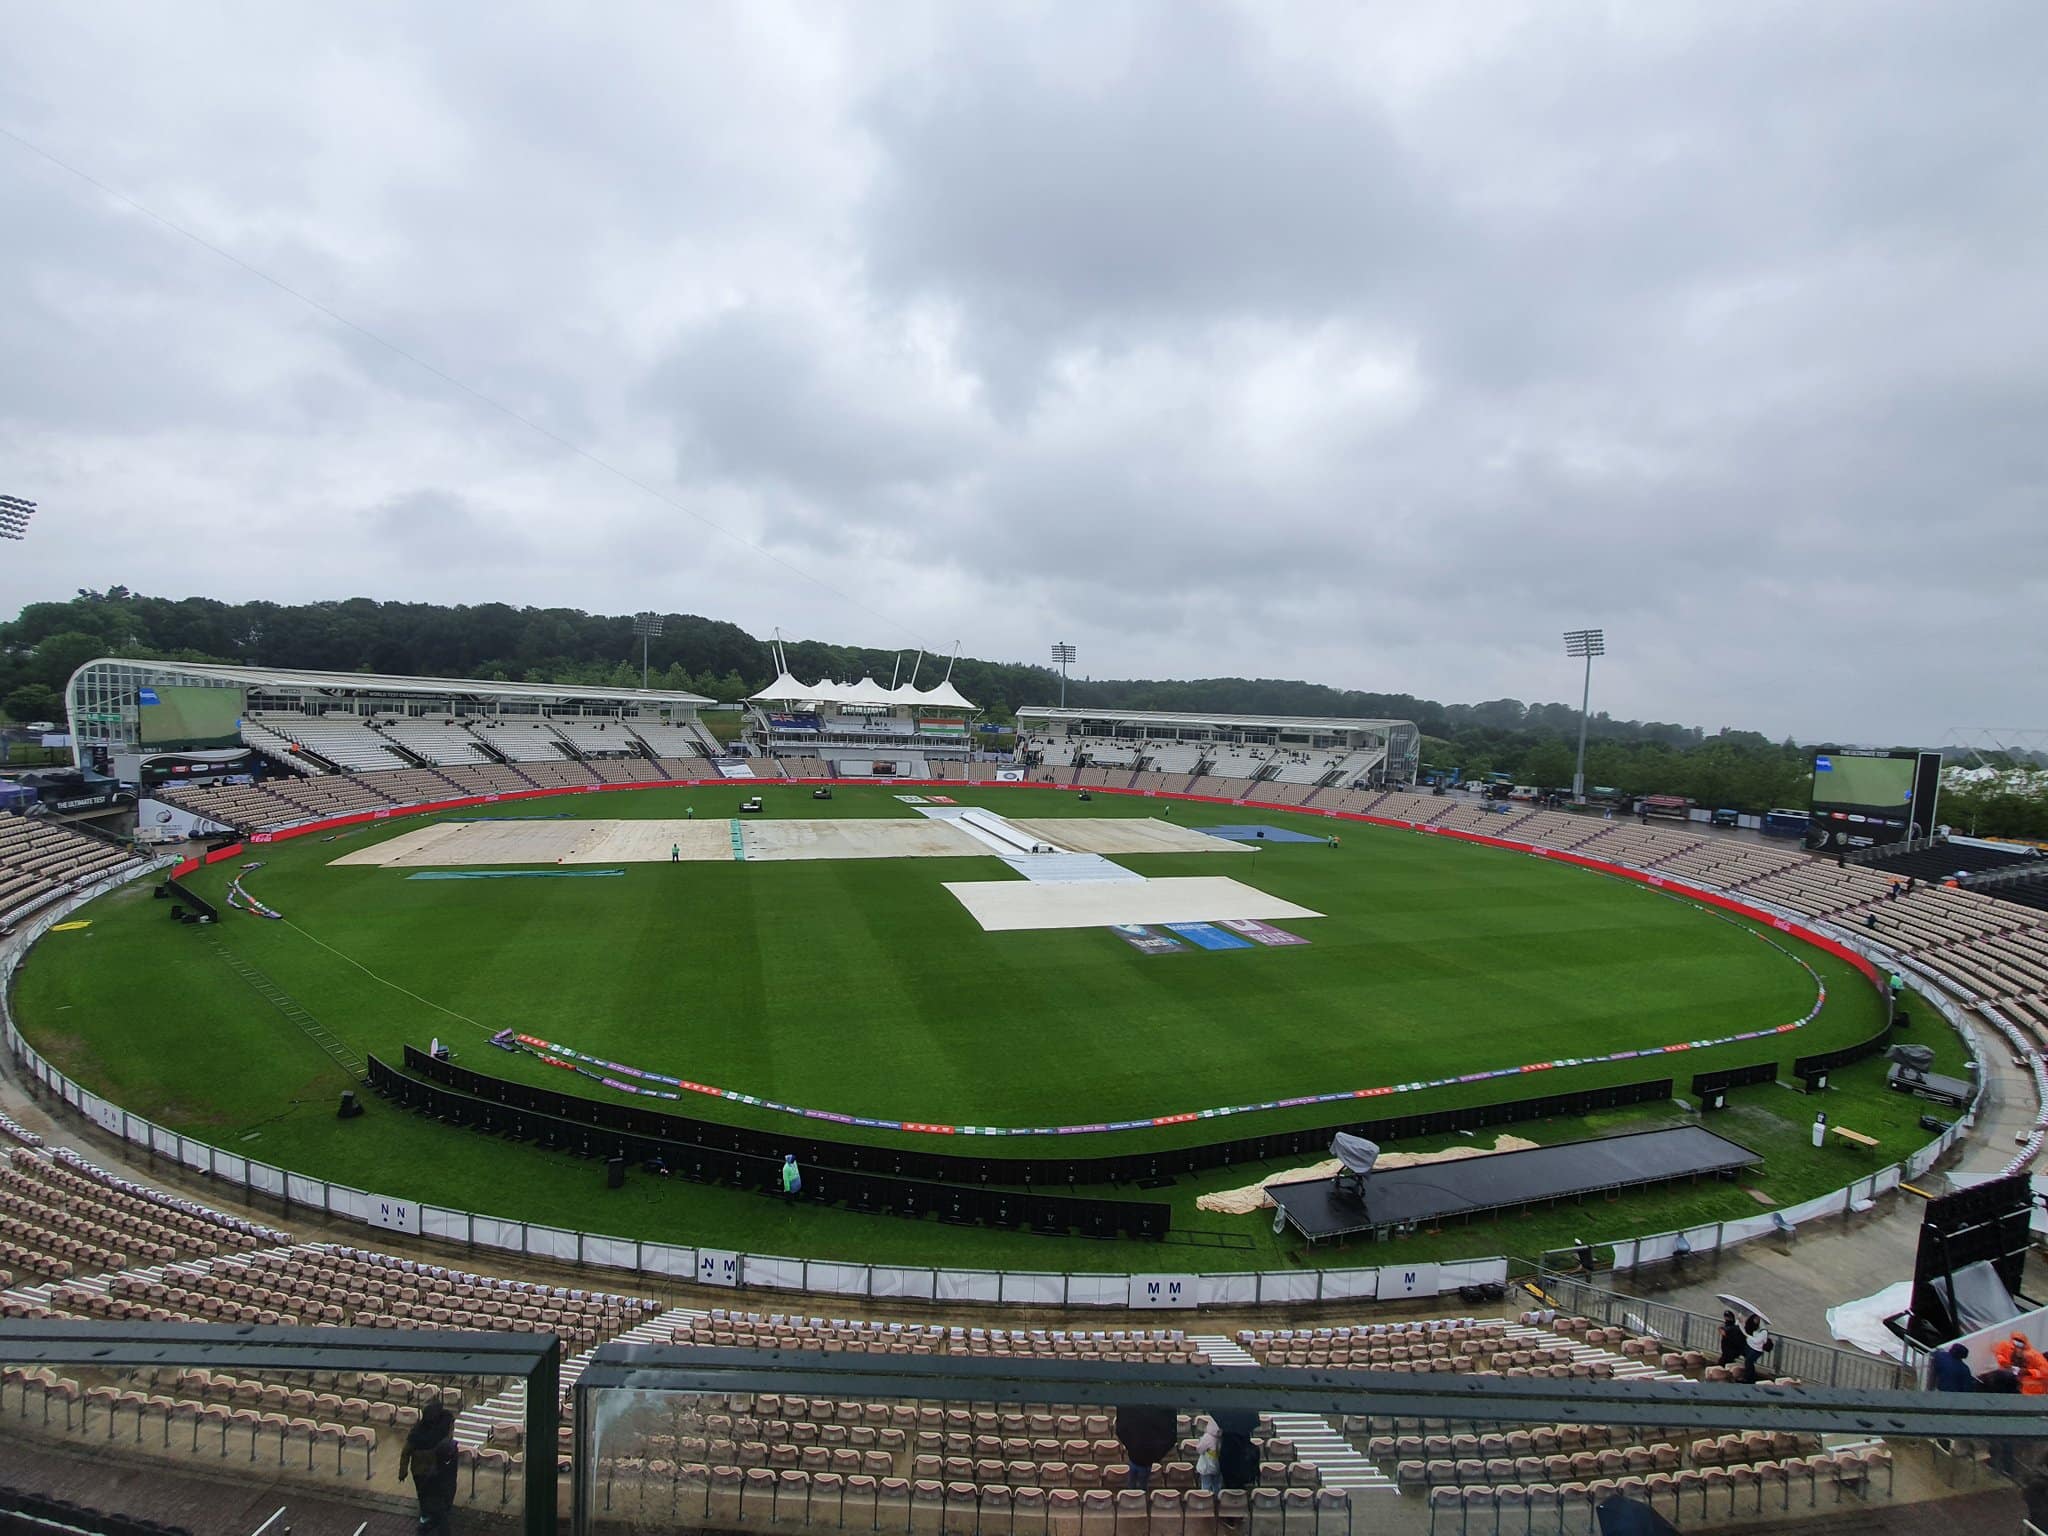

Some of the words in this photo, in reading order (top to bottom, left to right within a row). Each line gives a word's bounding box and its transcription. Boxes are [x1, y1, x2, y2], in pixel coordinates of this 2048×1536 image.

[381, 1203, 389, 1215] N
[397, 1207, 405, 1218] N
[704, 1257, 714, 1270] N
[724, 1259, 735, 1272] M
[1404, 1271, 1416, 1283] M
[1148, 1282, 1160, 1294] M
[1169, 1282, 1181, 1294] M
